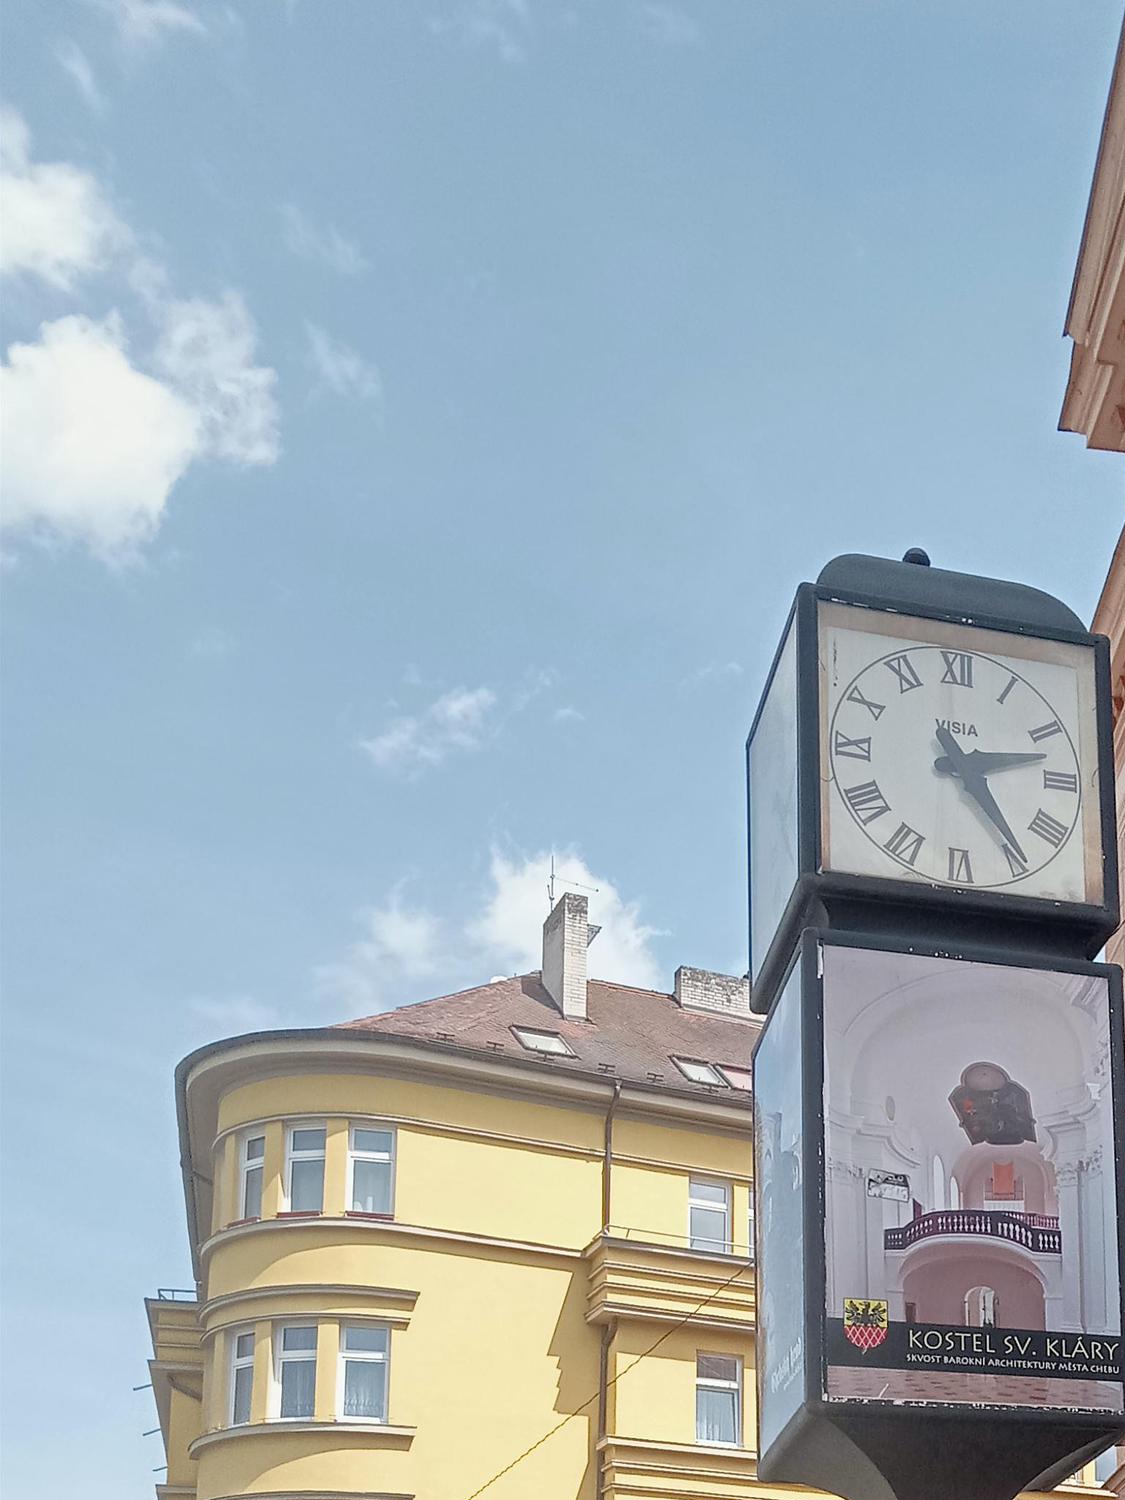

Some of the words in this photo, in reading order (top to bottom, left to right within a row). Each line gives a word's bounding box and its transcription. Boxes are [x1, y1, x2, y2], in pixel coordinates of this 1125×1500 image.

[883, 654, 924, 694] XI
[940, 650, 974, 688] XII
[846, 686, 886, 721] X
[996, 675, 1018, 704] I
[935, 718, 978, 737] VISIA
[1028, 719, 1063, 743] II
[835, 730, 872, 762] IX
[1043, 769, 1078, 793] III
[843, 779, 892, 826] VIII
[883, 822, 926, 866] VII
[1027, 808, 1069, 849] IIII
[947, 847, 974, 884] VI
[909, 1329, 996, 1354] KOSTEL
[1003, 1335, 1037, 1356] SV.
[1046, 1336, 1119, 1361] KLÁRY
[906, 1353, 942, 1363] SKVOST
[943, 1355, 986, 1366] BAROKNÍ
[988, 1358, 1057, 1370] ARCHITEKTURY
[1058, 1362, 1089, 1372] MĚSTA
[1087, 1365, 1120, 1374] CHEBU
